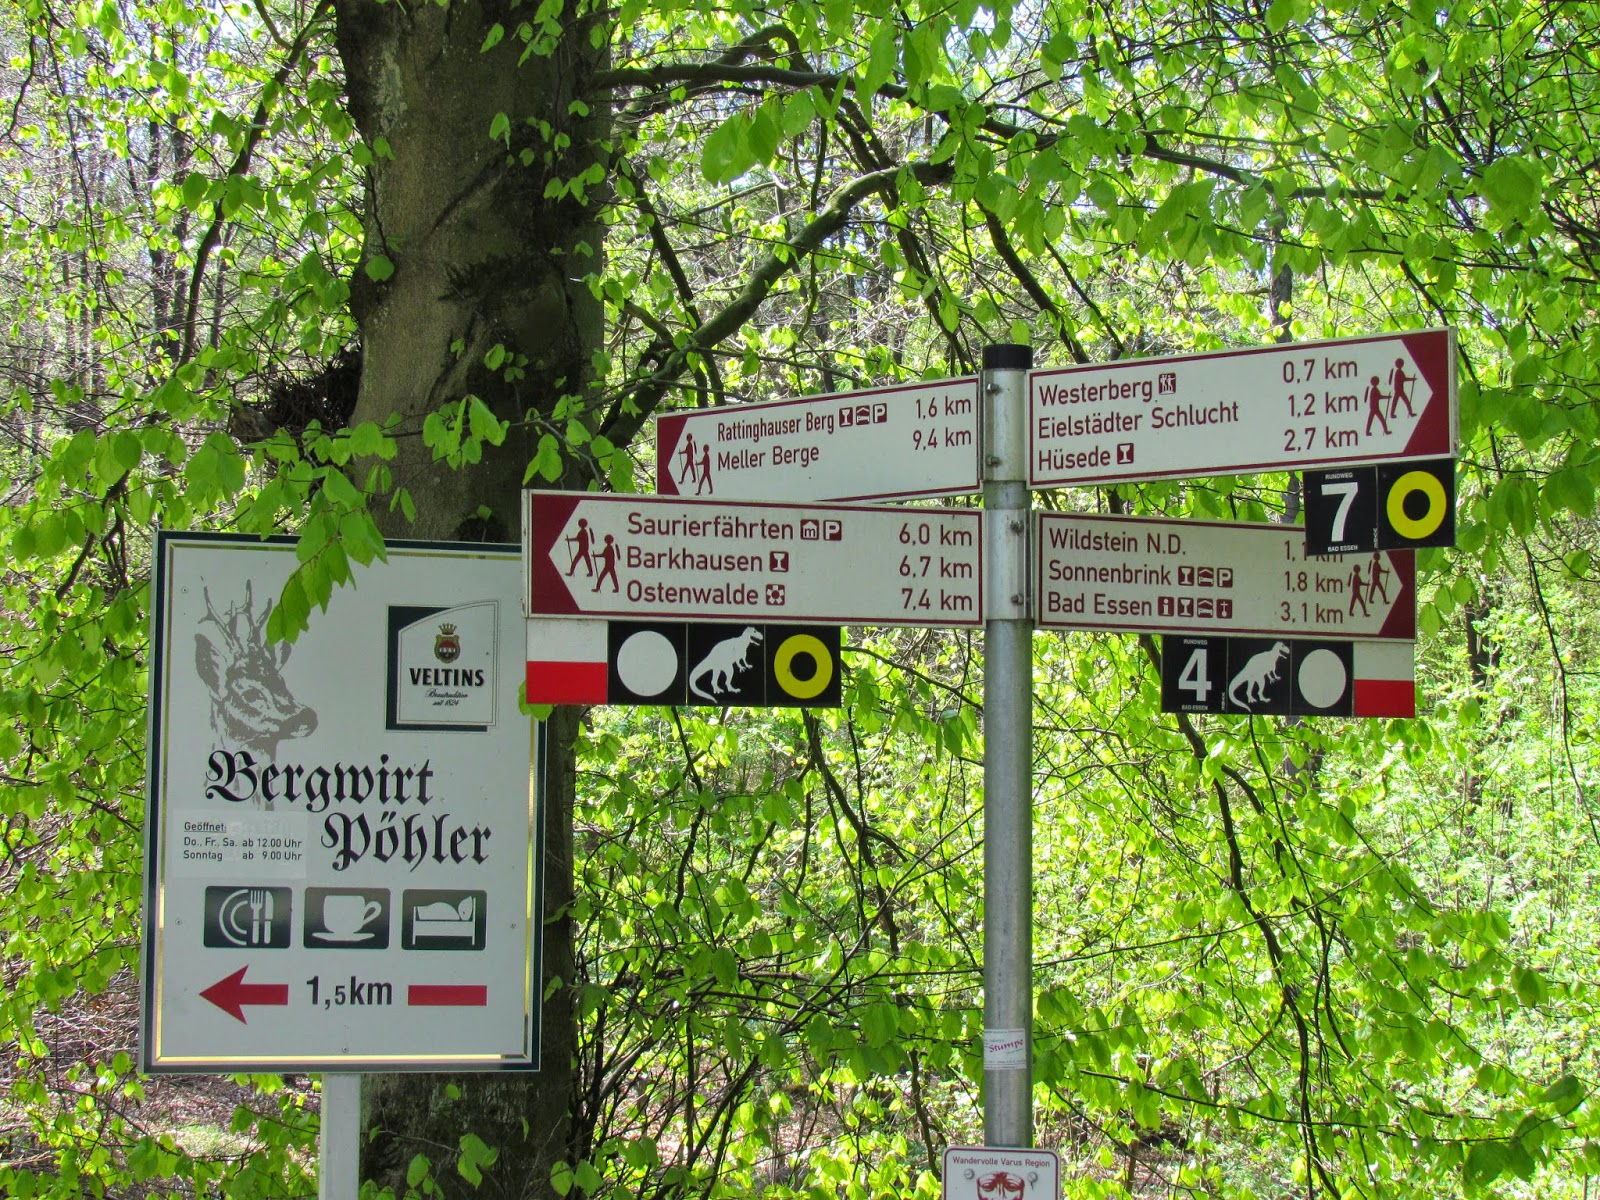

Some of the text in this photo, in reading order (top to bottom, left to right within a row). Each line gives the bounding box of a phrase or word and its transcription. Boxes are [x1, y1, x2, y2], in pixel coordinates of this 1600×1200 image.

[1038, 357, 1358, 407] Westerberg 0,7 km
[716, 413, 802, 443] Rattinghauser
[805, 411, 835, 435] Berg
[915, 398, 938, 420] 1,6
[944, 395, 972, 416] km
[1038, 391, 1359, 440] Eielstädter Schlucht 1,2 km
[717, 426, 972, 472] Meller Berge 9,4 km
[1038, 425, 1359, 472] Hüsede 2,7 km
[1325, 472, 1353, 480] RUNDWEG
[627, 511, 794, 540] Saurierfährten
[898, 522, 931, 546] 6,0
[939, 524, 973, 547] km
[1321, 482, 1359, 542] 7
[1048, 527, 1138, 553] Wildstein
[1146, 532, 1187, 556] N.D.
[626, 546, 973, 579] Barkhausen 6,7 km
[1048, 559, 1172, 587] Sonnenbrink
[1284, 570, 1308, 592] 1,8
[1315, 571, 1344, 594] km
[626, 579, 973, 612] Ostenwalde 7,4 km
[1047, 591, 1086, 614] Bad
[1093, 593, 1153, 617] Essen
[1280, 600, 1308, 623] 3,1
[1315, 602, 1344, 624] km
[409, 667, 485, 687] VELTINS
[1178, 648, 1212, 702] 4
[444, 699, 460, 707] 1824
[205, 749, 434, 813] Bergwirt
[184, 821, 227, 833] Geöffnet:
[222, 837, 238, 848] Sa.
[242, 837, 254, 848] ab
[257, 837, 282, 848] 12.00
[284, 838, 303, 849] Uhr
[320, 810, 493, 873] Pöhler
[183, 849, 303, 862] Sonntag ab 9.00 Uhr
[952, 1155, 1051, 1169] Wandervolle Varus Region
